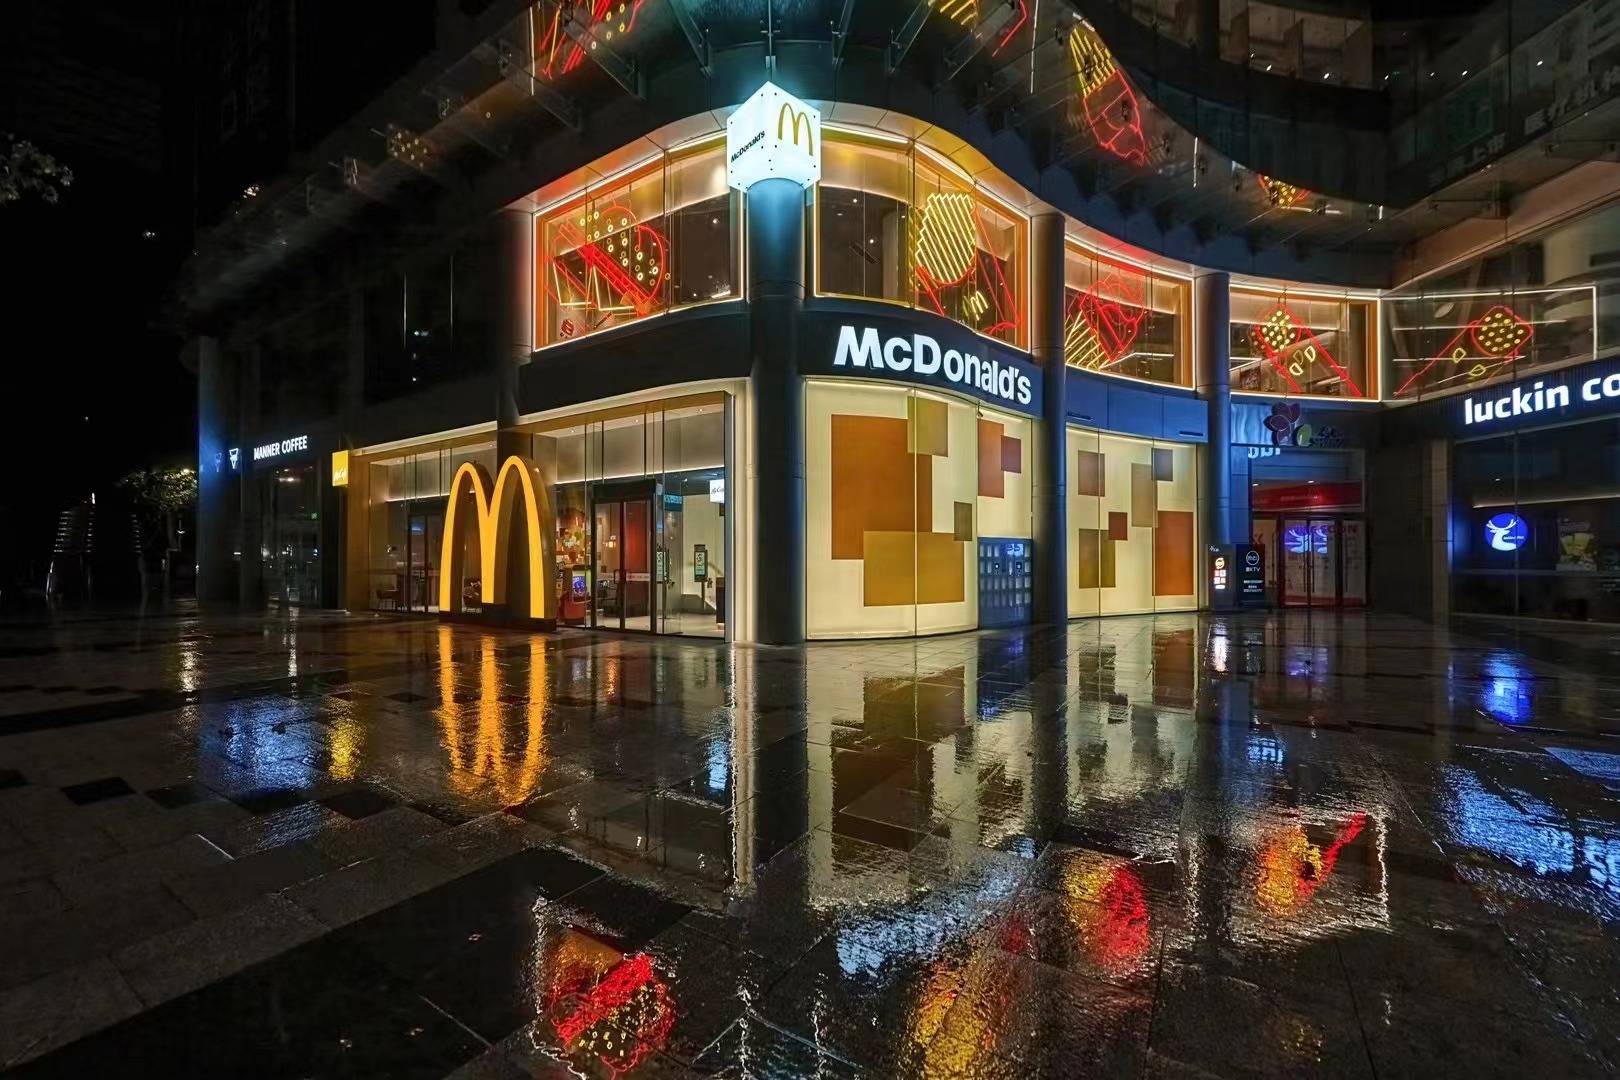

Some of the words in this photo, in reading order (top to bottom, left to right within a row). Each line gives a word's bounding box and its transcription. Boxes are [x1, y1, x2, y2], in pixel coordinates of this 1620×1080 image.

[731, 130, 765, 163] McDonald's
[833, 325, 1032, 405] McDonald's
[1464, 381, 1570, 425] luckin
[253, 442, 281, 460] MANNER
[281, 435, 308, 454] COFFEE
